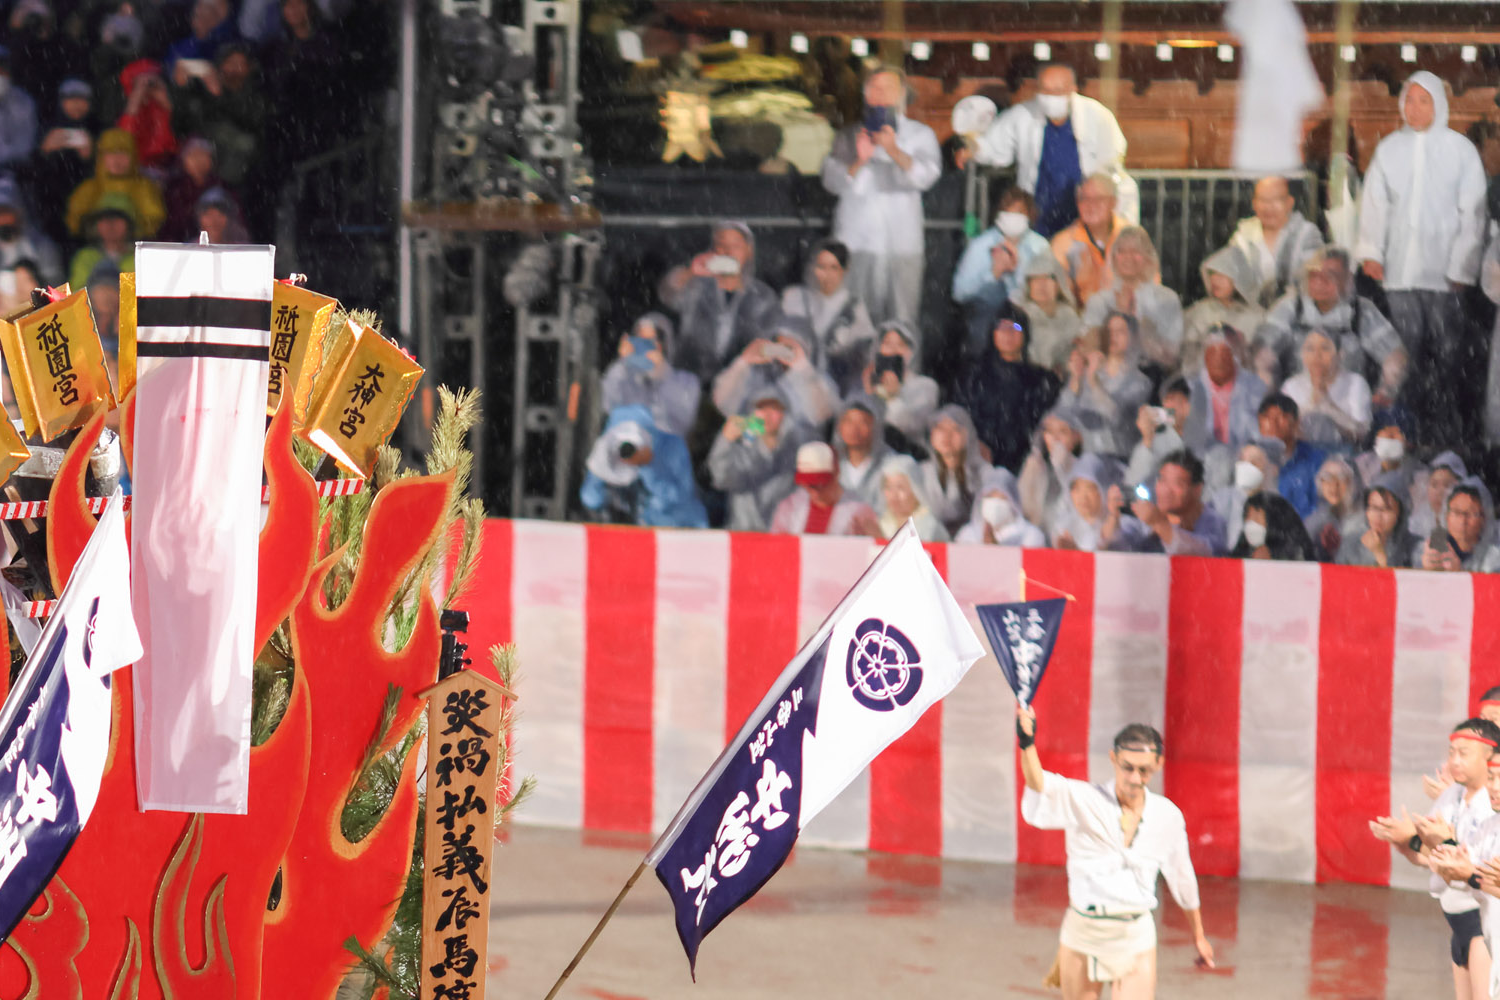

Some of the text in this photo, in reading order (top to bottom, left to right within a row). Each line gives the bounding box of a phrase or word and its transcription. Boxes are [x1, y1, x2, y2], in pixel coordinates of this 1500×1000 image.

[36, 313, 79, 406] 祇園宮
[339, 363, 384, 439] 大神宮
